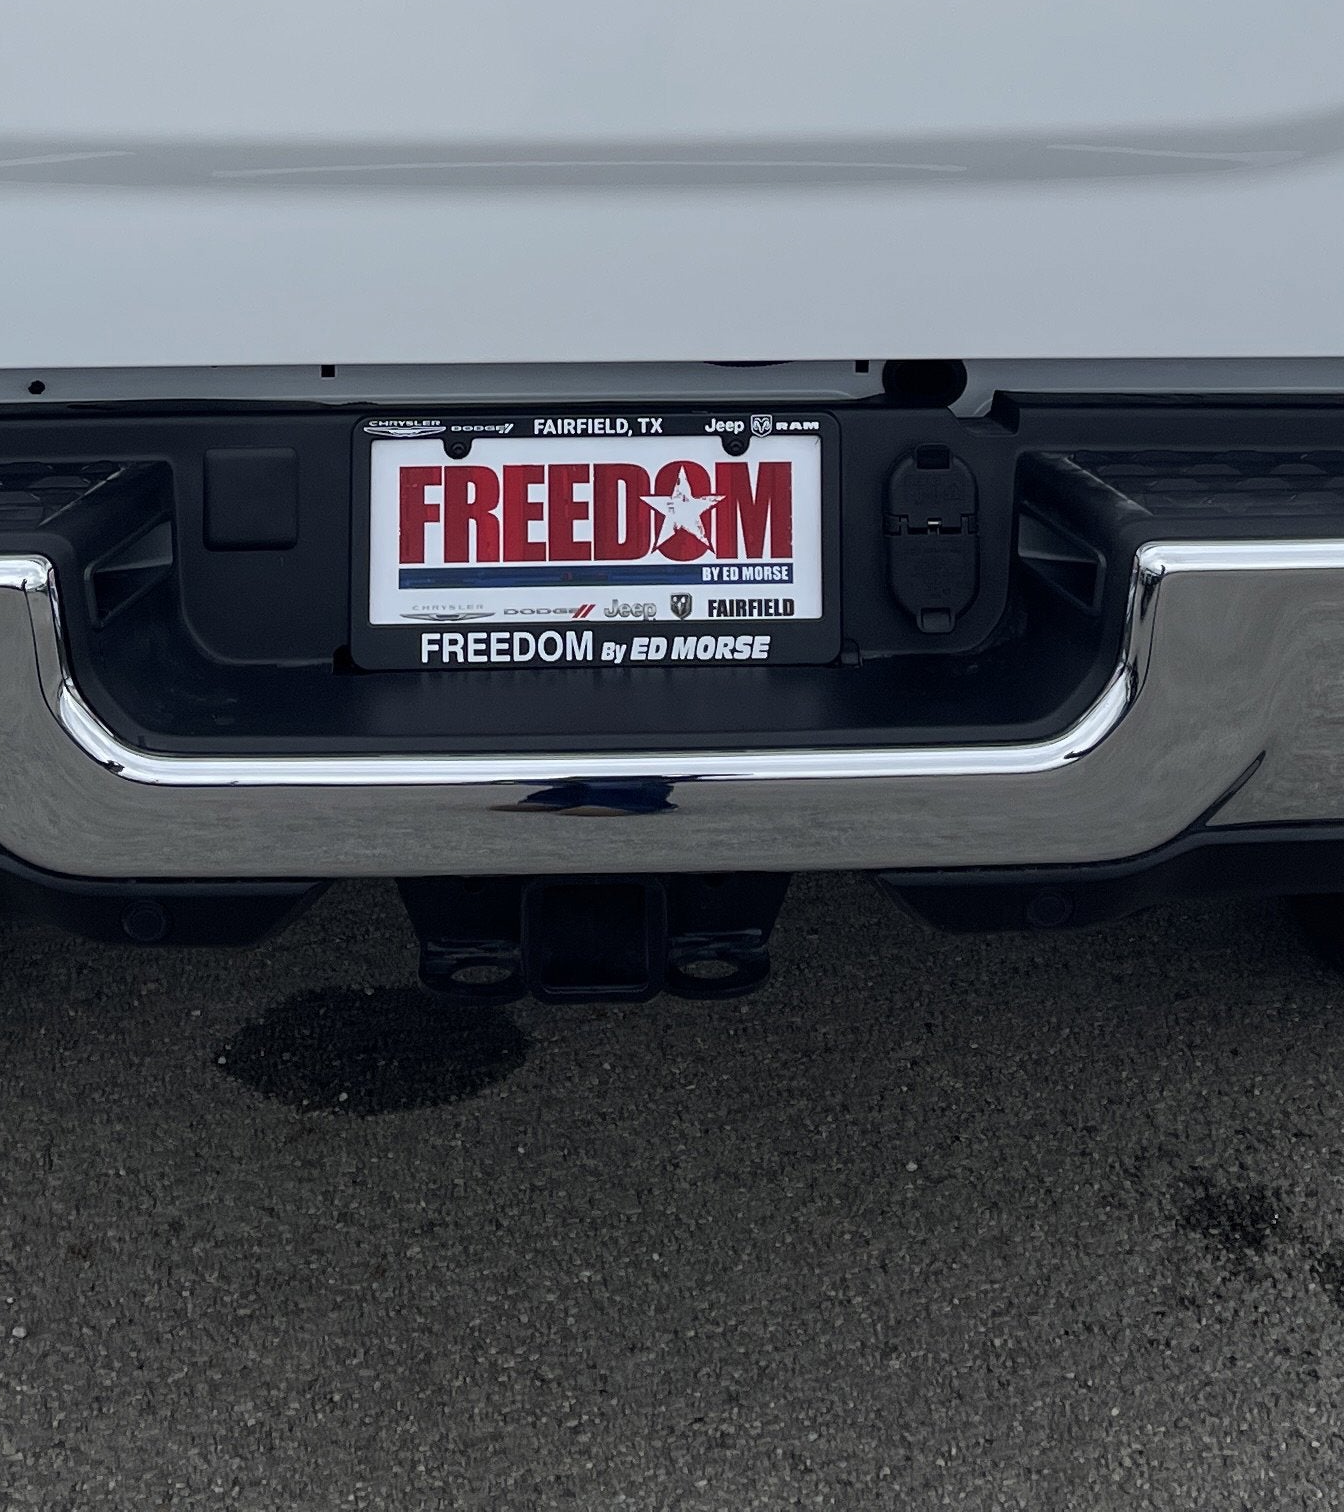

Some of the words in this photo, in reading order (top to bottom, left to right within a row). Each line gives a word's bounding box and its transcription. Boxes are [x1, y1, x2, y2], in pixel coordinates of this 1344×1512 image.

[450, 424, 506, 432] DODGE
[533, 418, 633, 437] FAIRFIELD,
[637, 417, 663, 434] TX
[704, 417, 745, 435] Jeep
[775, 421, 820, 431] RAM
[398, 460, 794, 565] FREEDOM
[701, 567, 720, 582] BY
[722, 566, 739, 581] ED
[742, 565, 790, 581] MORSE
[411, 604, 485, 612] CHRYSLER
[503, 608, 579, 616] DODGE
[603, 599, 657, 622] Jeep
[707, 597, 796, 618] FAIRFIELD
[421, 630, 594, 664] FREEDOM
[600, 641, 627, 664] By
[629, 636, 668, 661] ED
[670, 635, 771, 661] MORSE
